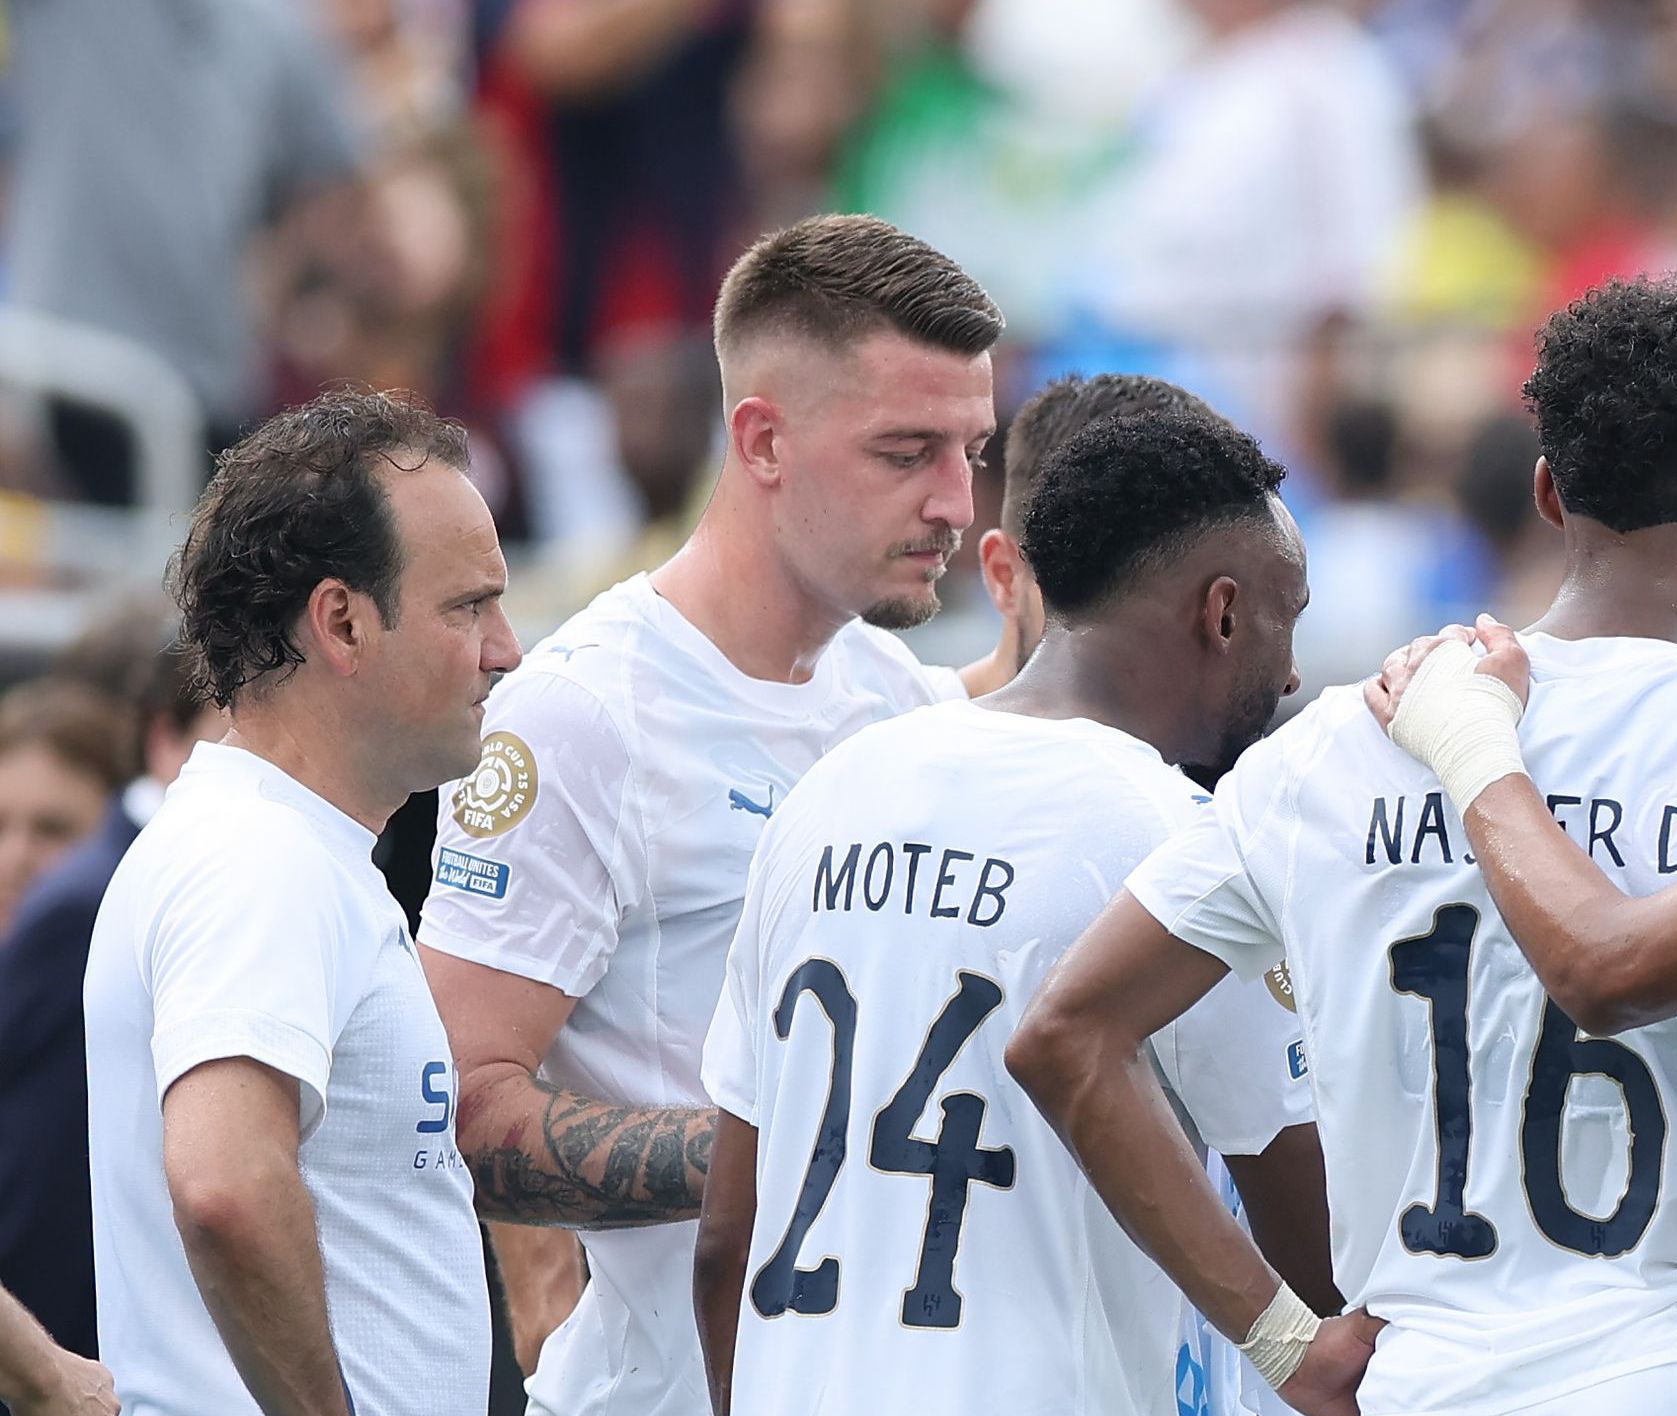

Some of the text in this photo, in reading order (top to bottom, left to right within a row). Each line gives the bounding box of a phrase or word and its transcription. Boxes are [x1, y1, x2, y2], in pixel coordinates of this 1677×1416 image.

[504, 746, 525, 768] CUP
[518, 771, 528, 790] 25
[501, 793, 525, 818] USA
[464, 808, 494, 831] FIFA
[467, 857, 500, 878] UNITES
[472, 878, 494, 891] FIFA
[812, 842, 1015, 927] MOTEB
[1388, 903, 1668, 1260] 16
[750, 957, 1016, 1330] 24
